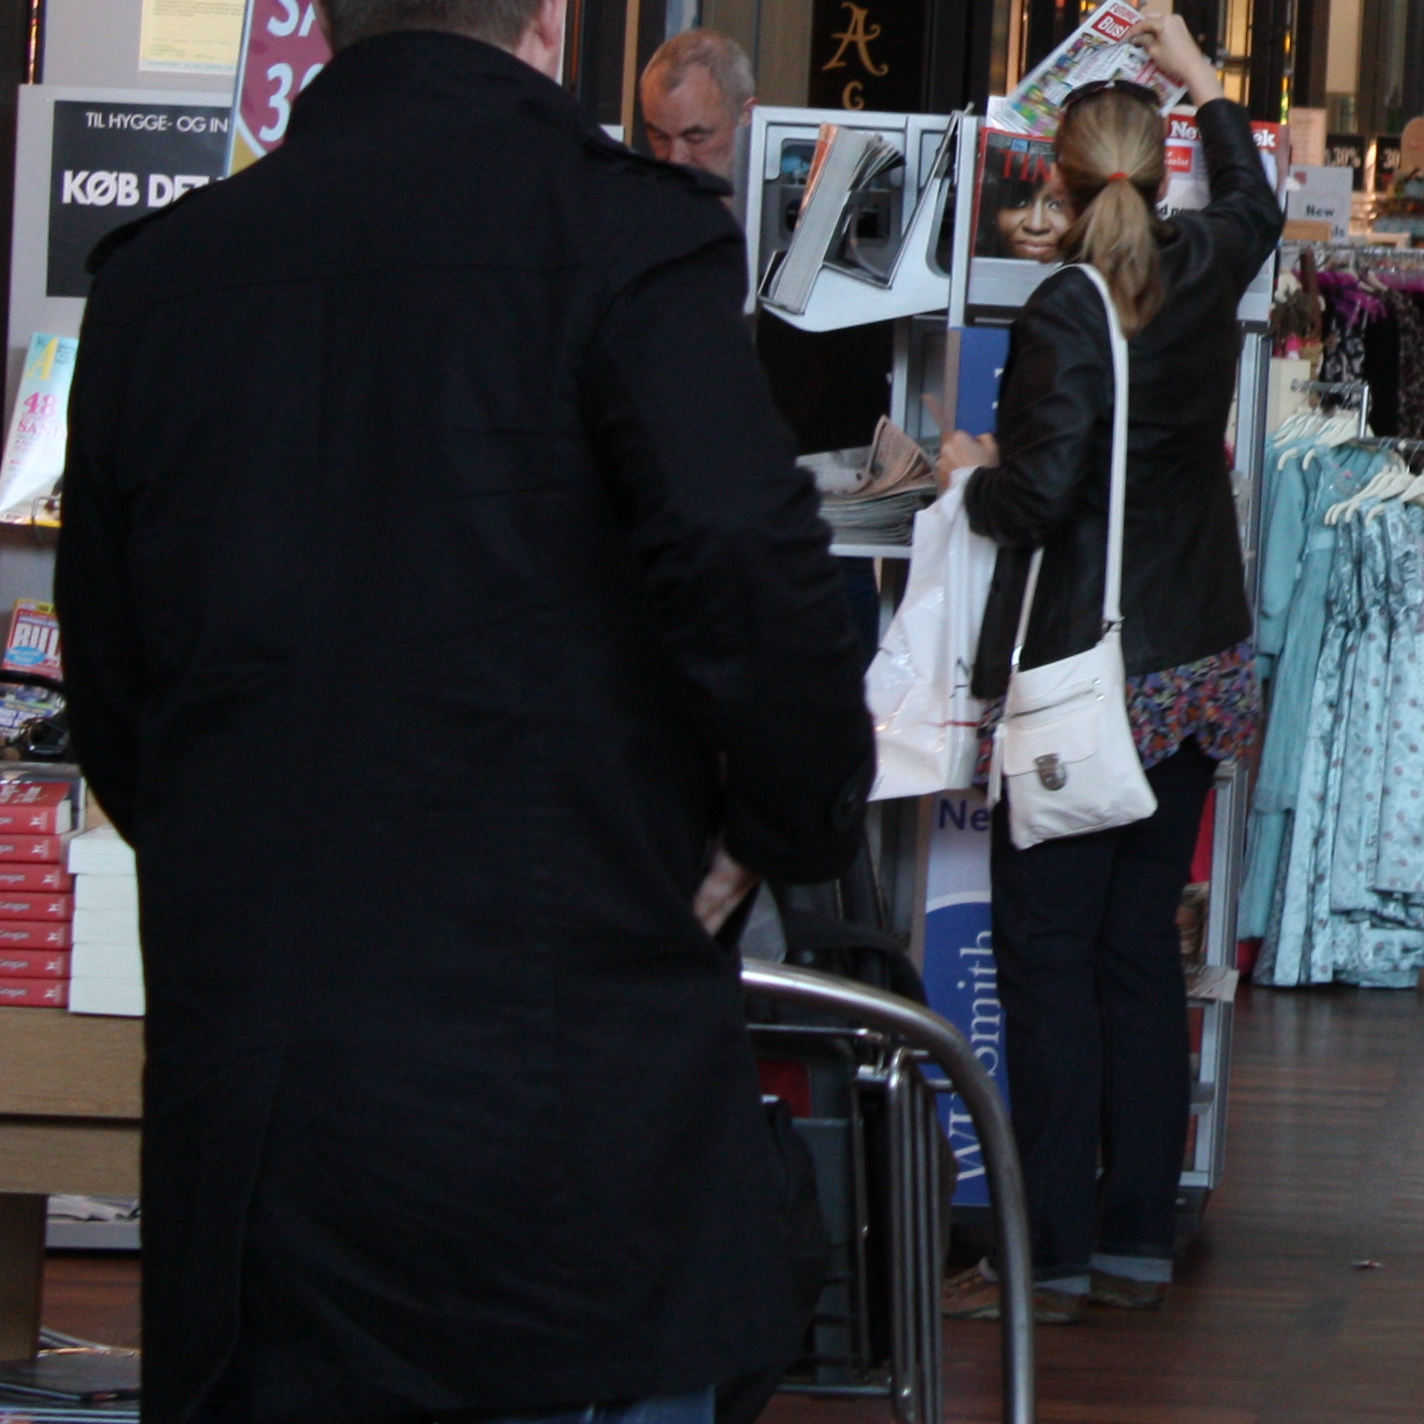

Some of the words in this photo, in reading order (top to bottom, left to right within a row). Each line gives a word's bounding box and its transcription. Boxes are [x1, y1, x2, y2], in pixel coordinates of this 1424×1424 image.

[85, 112, 105, 129] TIL
[109, 113, 173, 130] HYGGE-
[177, 115, 206, 133] OG
[62, 169, 140, 207] KØB
